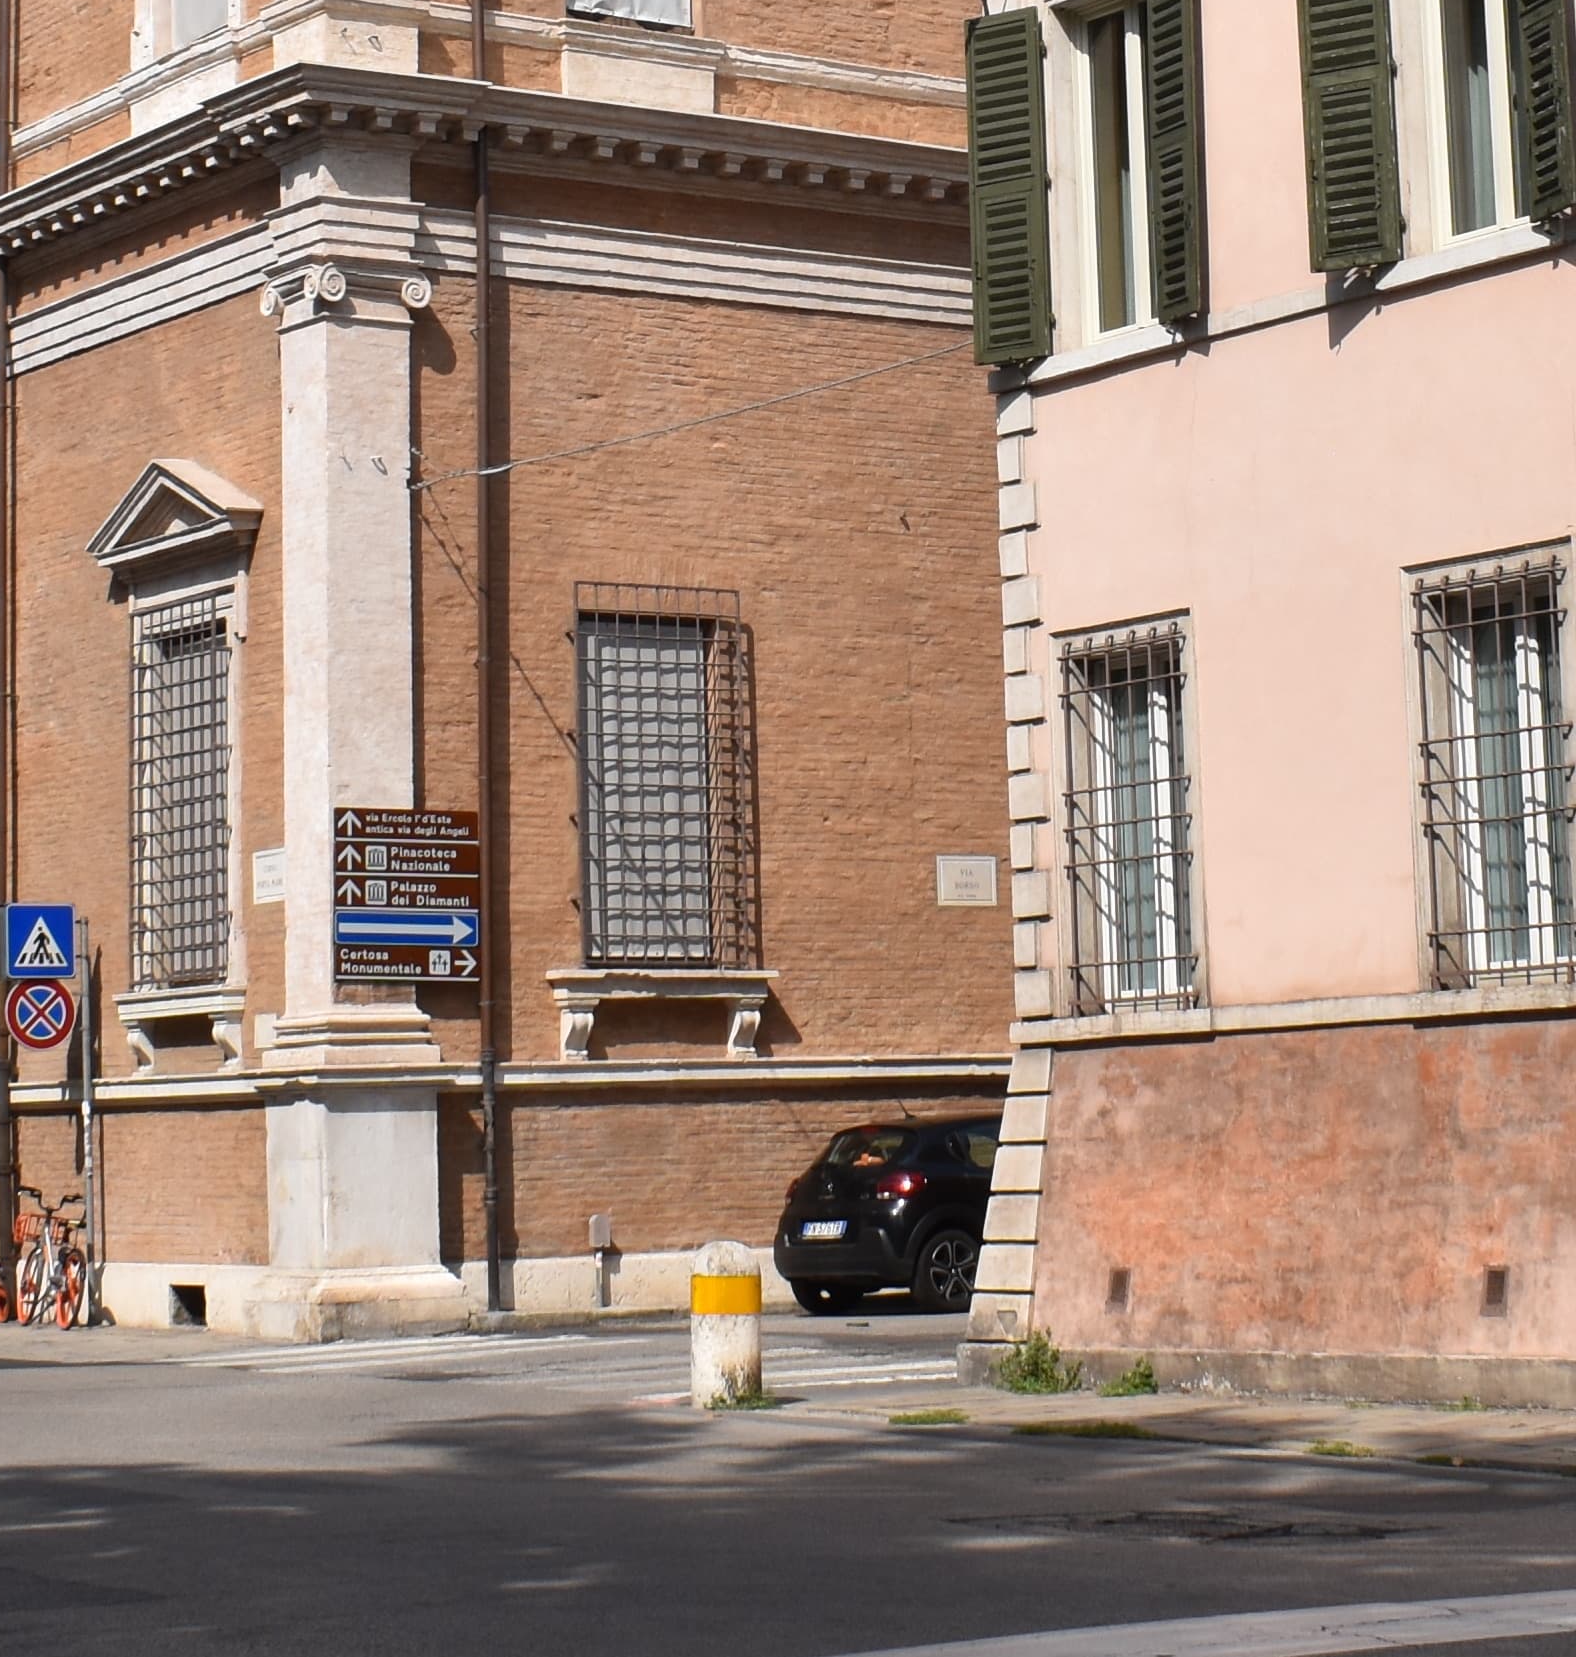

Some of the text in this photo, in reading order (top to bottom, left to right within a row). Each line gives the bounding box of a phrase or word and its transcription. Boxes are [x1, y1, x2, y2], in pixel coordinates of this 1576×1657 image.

[365, 813, 379, 822] via
[365, 825, 469, 838] antica via degli Angeli
[390, 846, 457, 859] Pinacoteca
[390, 860, 451, 872] Nazionale
[390, 880, 437, 893] Palazzo
[391, 894, 470, 907] dei Diamanti
[340, 948, 389, 960] Certosa
[341, 962, 422, 975] Monumentale
